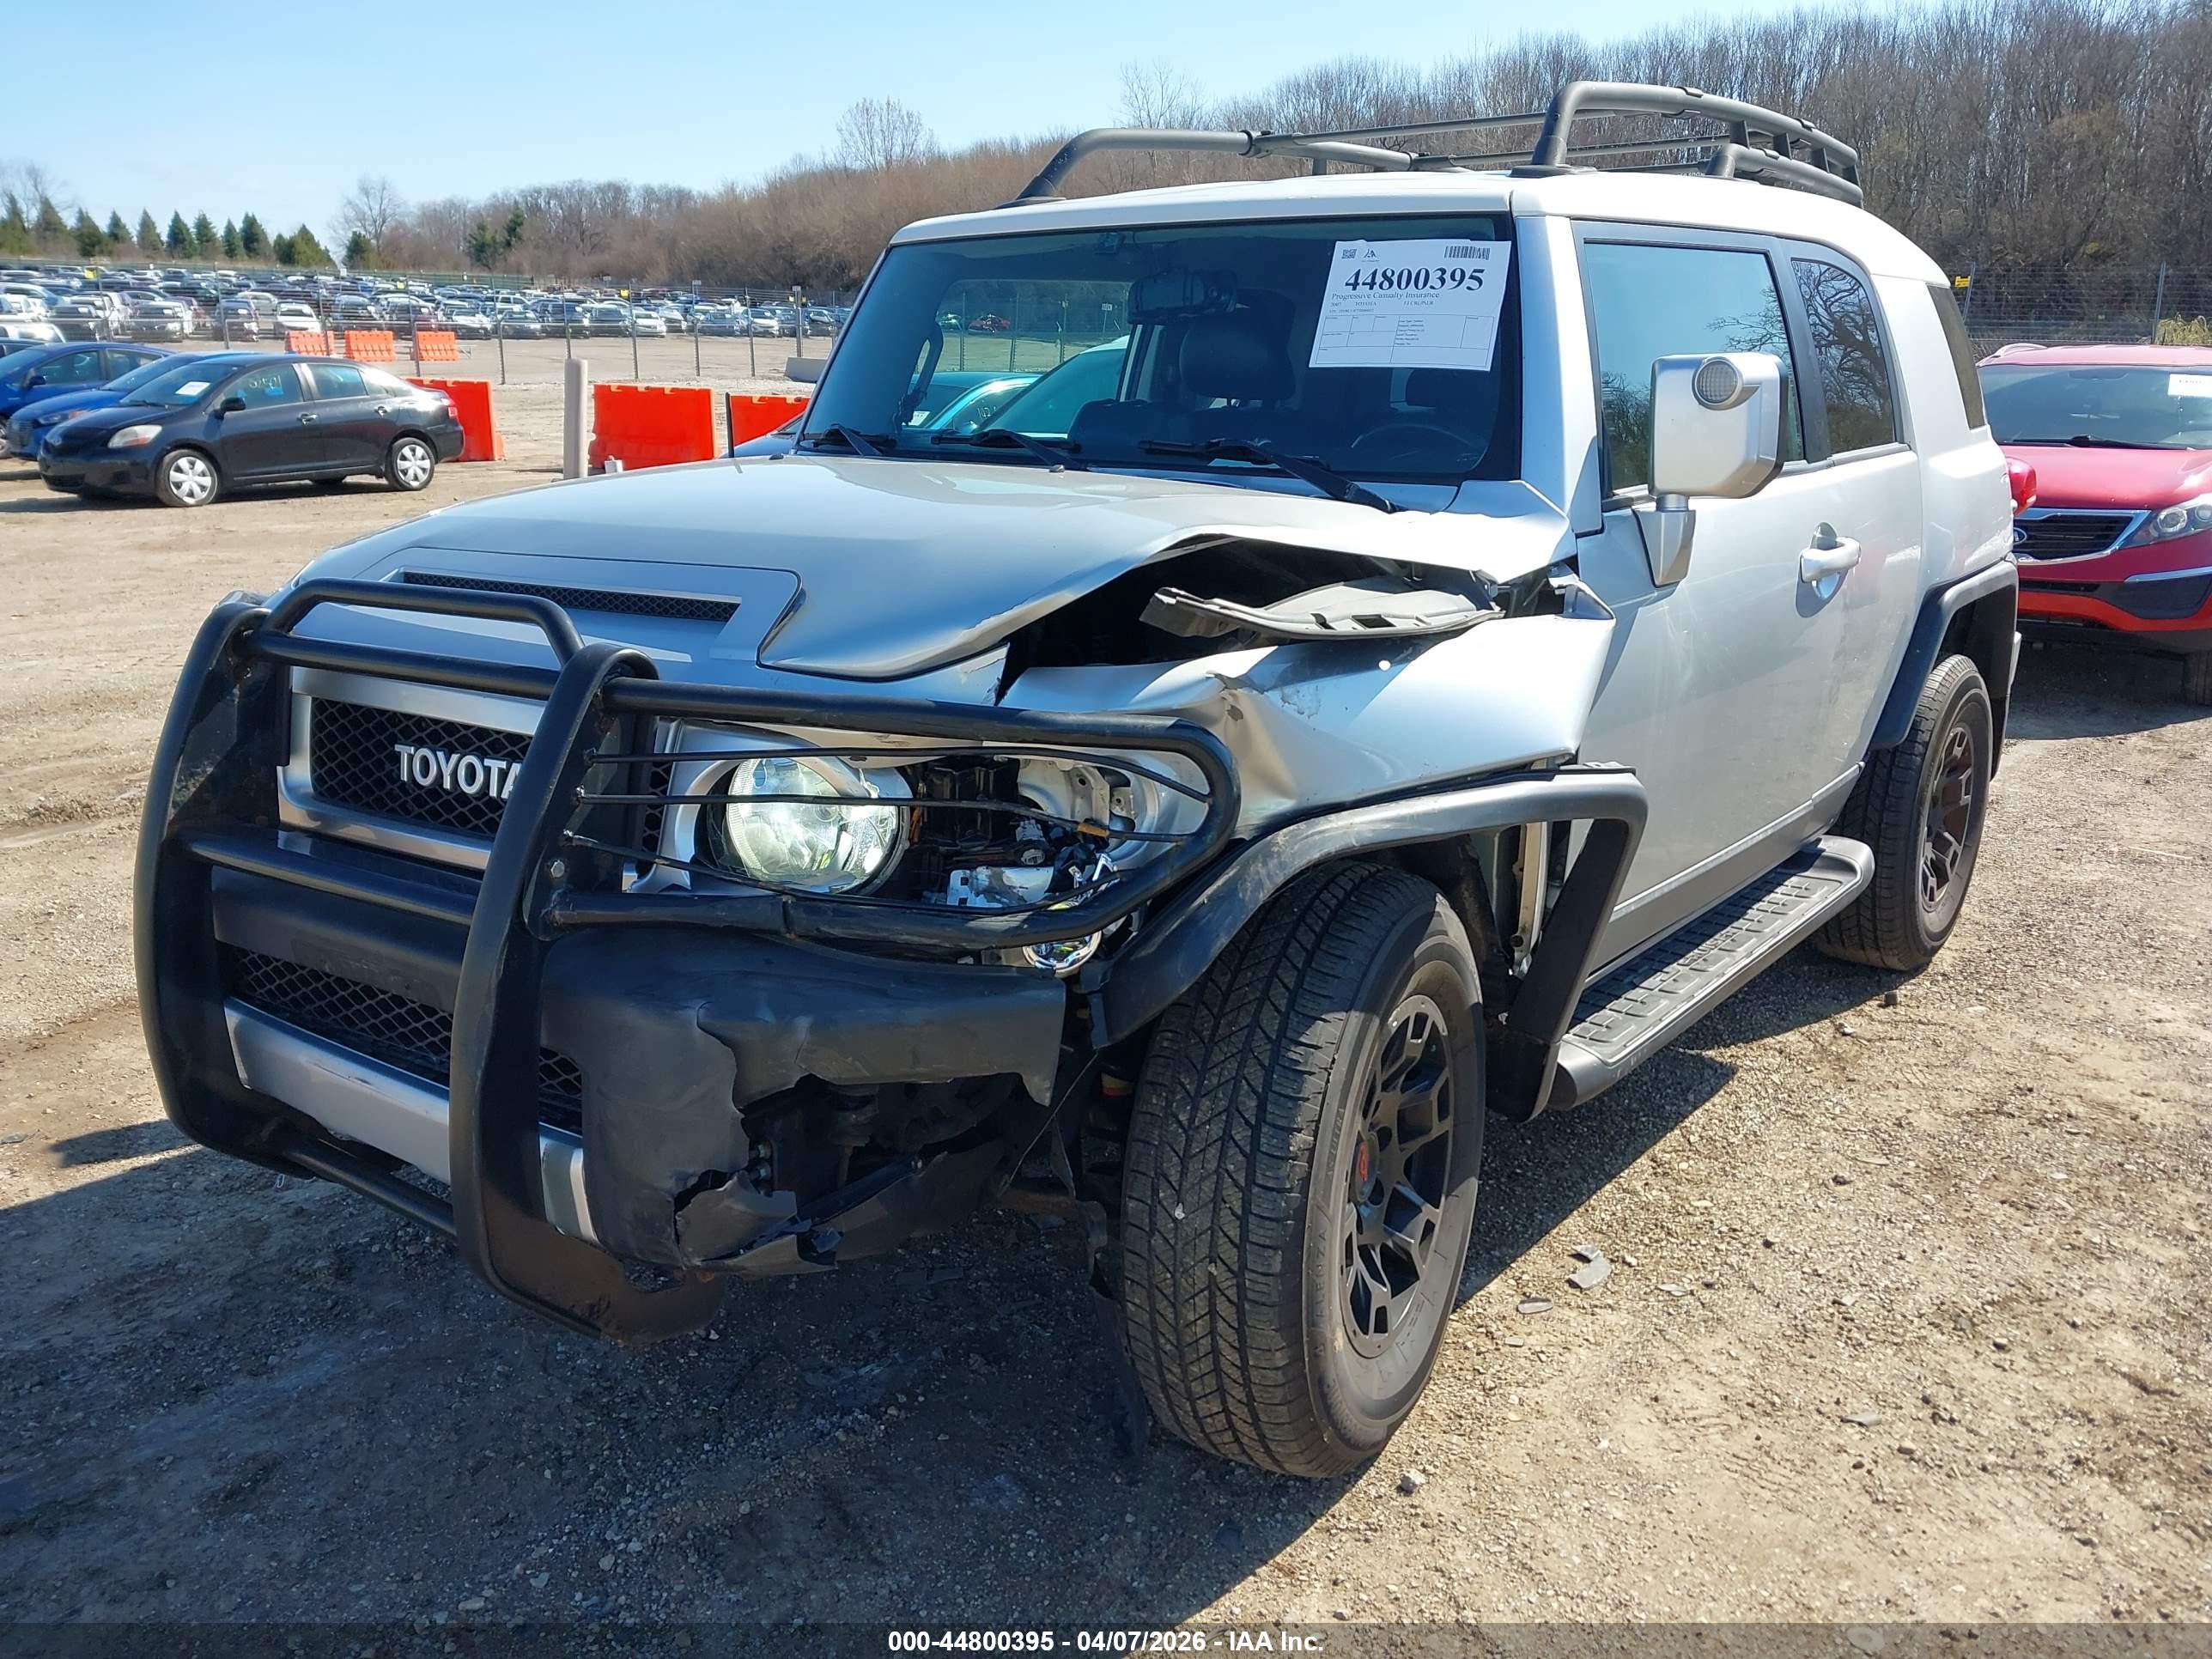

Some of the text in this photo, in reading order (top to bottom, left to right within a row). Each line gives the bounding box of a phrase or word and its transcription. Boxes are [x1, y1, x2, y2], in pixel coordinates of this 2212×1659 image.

[1345, 267, 1486, 291] 44800395
[1332, 292, 1371, 301] Progressive
[1373, 291, 1404, 300] Casualty
